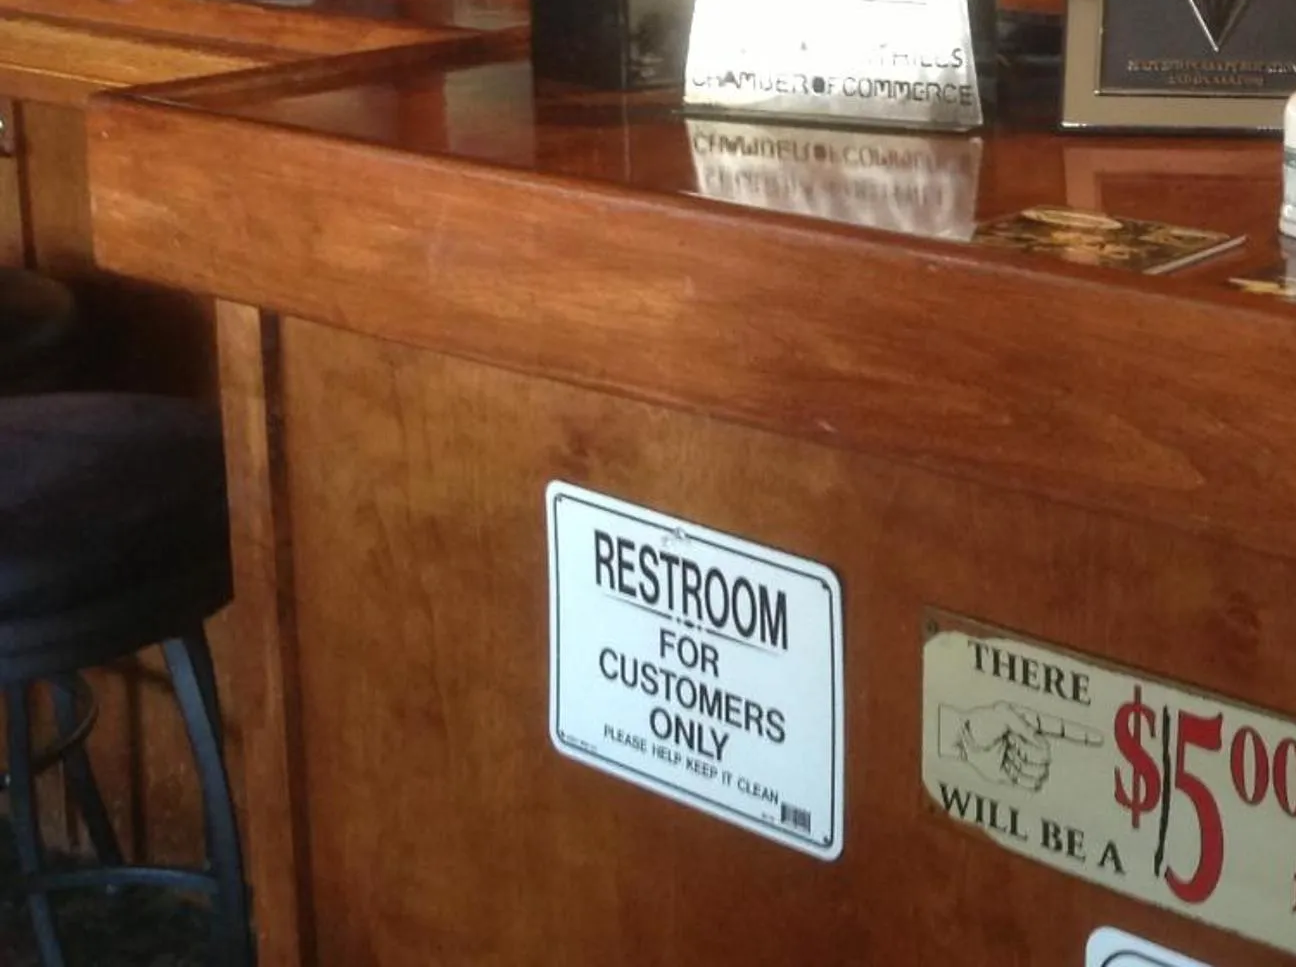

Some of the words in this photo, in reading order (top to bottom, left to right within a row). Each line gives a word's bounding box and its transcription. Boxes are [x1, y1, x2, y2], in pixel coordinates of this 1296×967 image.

[842, 76, 974, 107] COMMERCE
[593, 528, 789, 651] RESTROOM
[659, 627, 720, 678] FOR
[966, 638, 1093, 707] THERE
[599, 647, 786, 745] CUSTOMERS
[649, 706, 730, 762] ONLY
[603, 723, 648, 752] PLEASE
[651, 742, 682, 766] HELP
[685, 756, 719, 779] KEEP
[721, 769, 733, 787] IT
[736, 775, 779, 806] CLEAN
[938, 782, 1028, 843] WILL
[1040, 816, 1088, 864] BE
[1098, 839, 1127, 877] A
